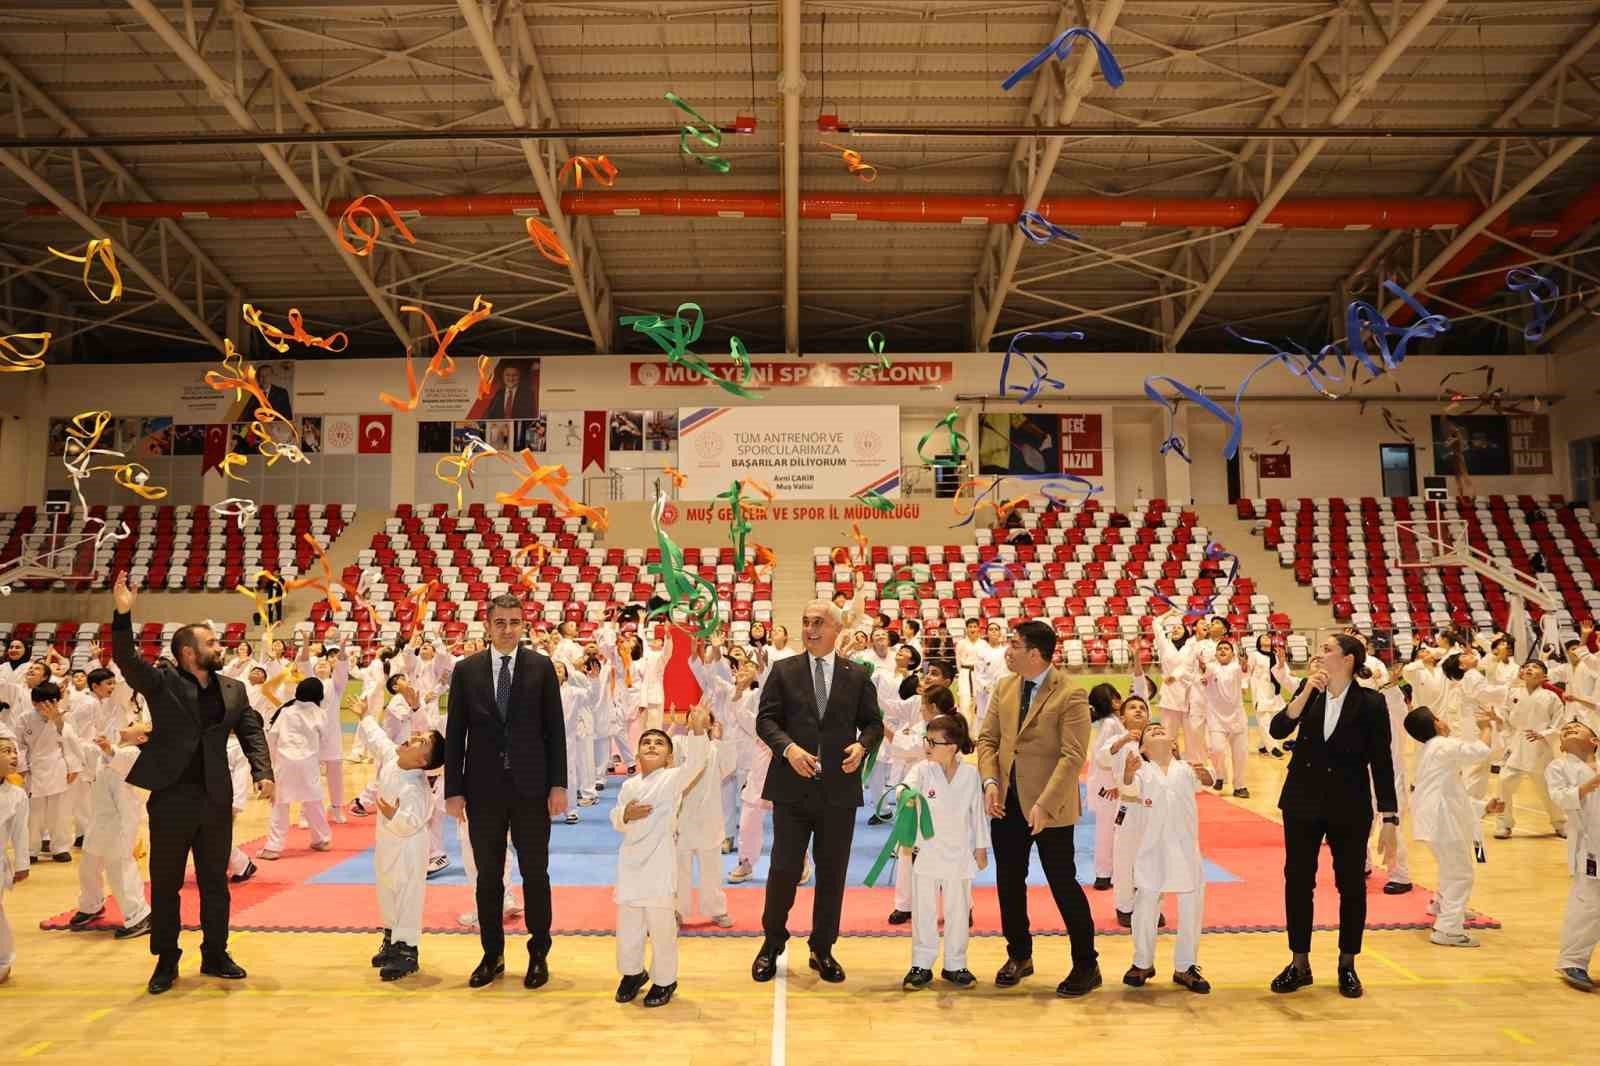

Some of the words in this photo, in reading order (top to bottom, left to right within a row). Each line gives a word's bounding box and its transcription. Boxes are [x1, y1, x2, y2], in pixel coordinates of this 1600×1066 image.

[779, 366, 842, 382] SPOR
[848, 366, 942, 382] SALONU
[734, 432, 761, 443] TÜM
[764, 432, 827, 443] ANTRENÖR
[829, 432, 844, 443] VE
[737, 444, 841, 456] SPORCULARIMIZA
[731, 458, 788, 469] BAŞARILAR
[790, 457, 847, 467] DİLİYORUM
[686, 508, 713, 525] MUŞ
[772, 507, 789, 520] VE
[792, 507, 825, 520] SPOR
[829, 503, 840, 520] İL
